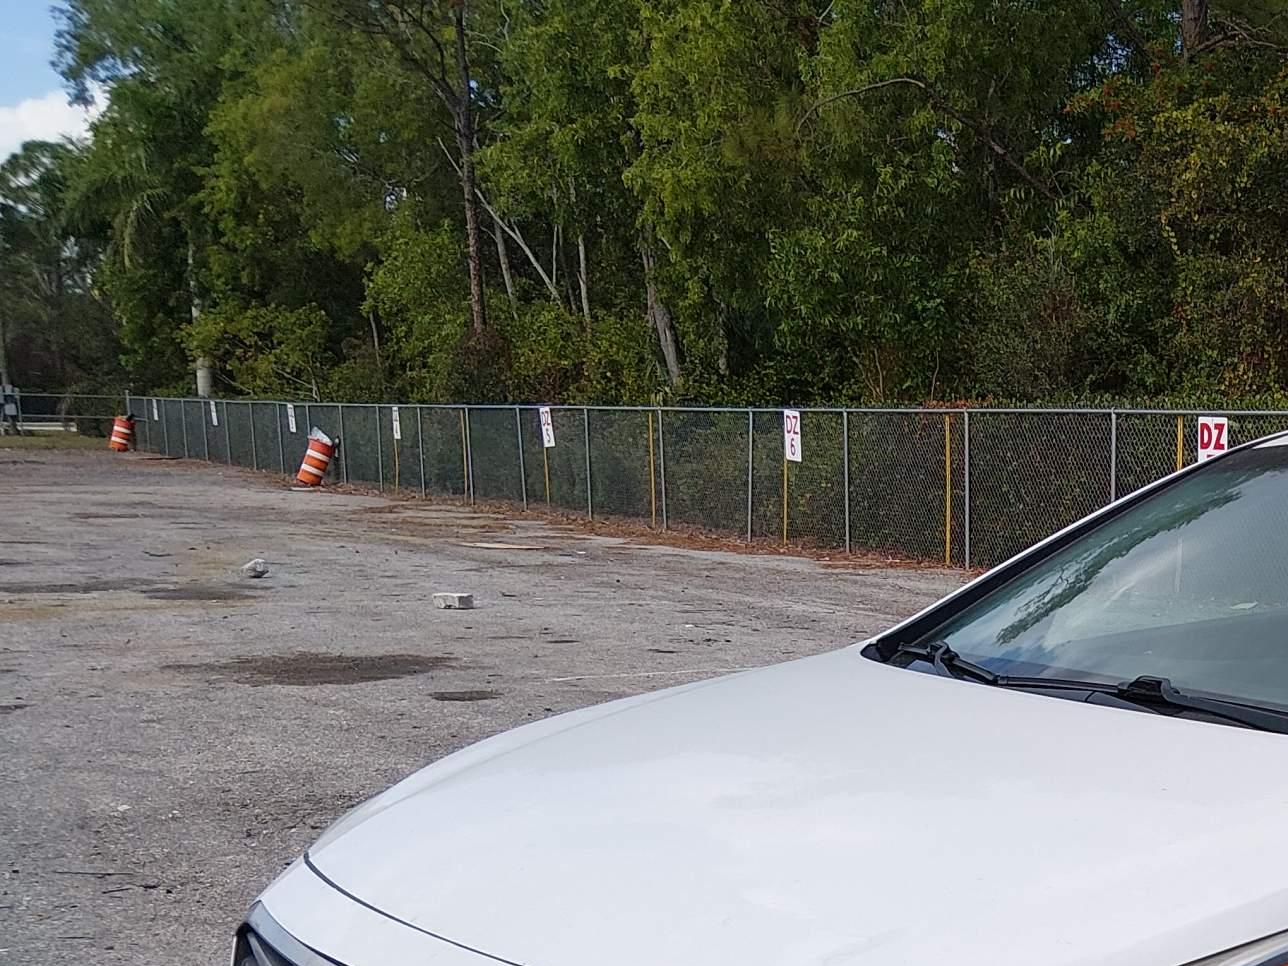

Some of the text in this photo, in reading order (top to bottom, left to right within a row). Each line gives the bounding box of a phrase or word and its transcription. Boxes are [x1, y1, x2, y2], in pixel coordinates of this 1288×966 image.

[786, 415, 799, 435] DZ
[790, 437, 796, 456] 6
[1200, 423, 1225, 450] DZ
